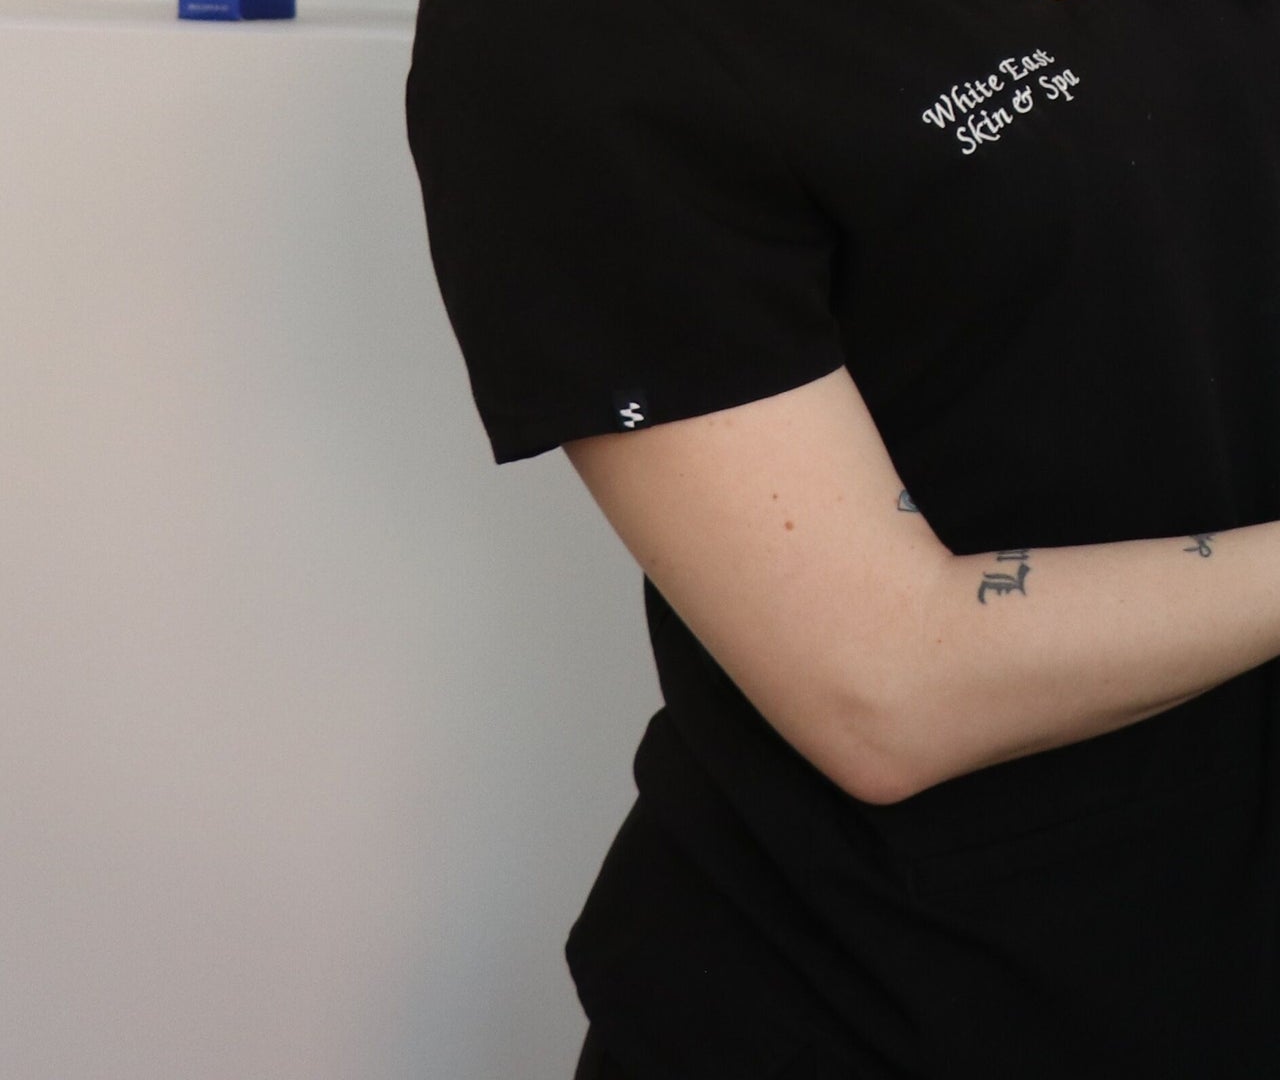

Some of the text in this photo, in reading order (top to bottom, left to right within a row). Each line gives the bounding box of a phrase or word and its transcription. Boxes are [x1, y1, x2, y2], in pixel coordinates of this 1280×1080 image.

[922, 48, 1055, 129] White East
[956, 69, 1080, 155] Skin & Spa
